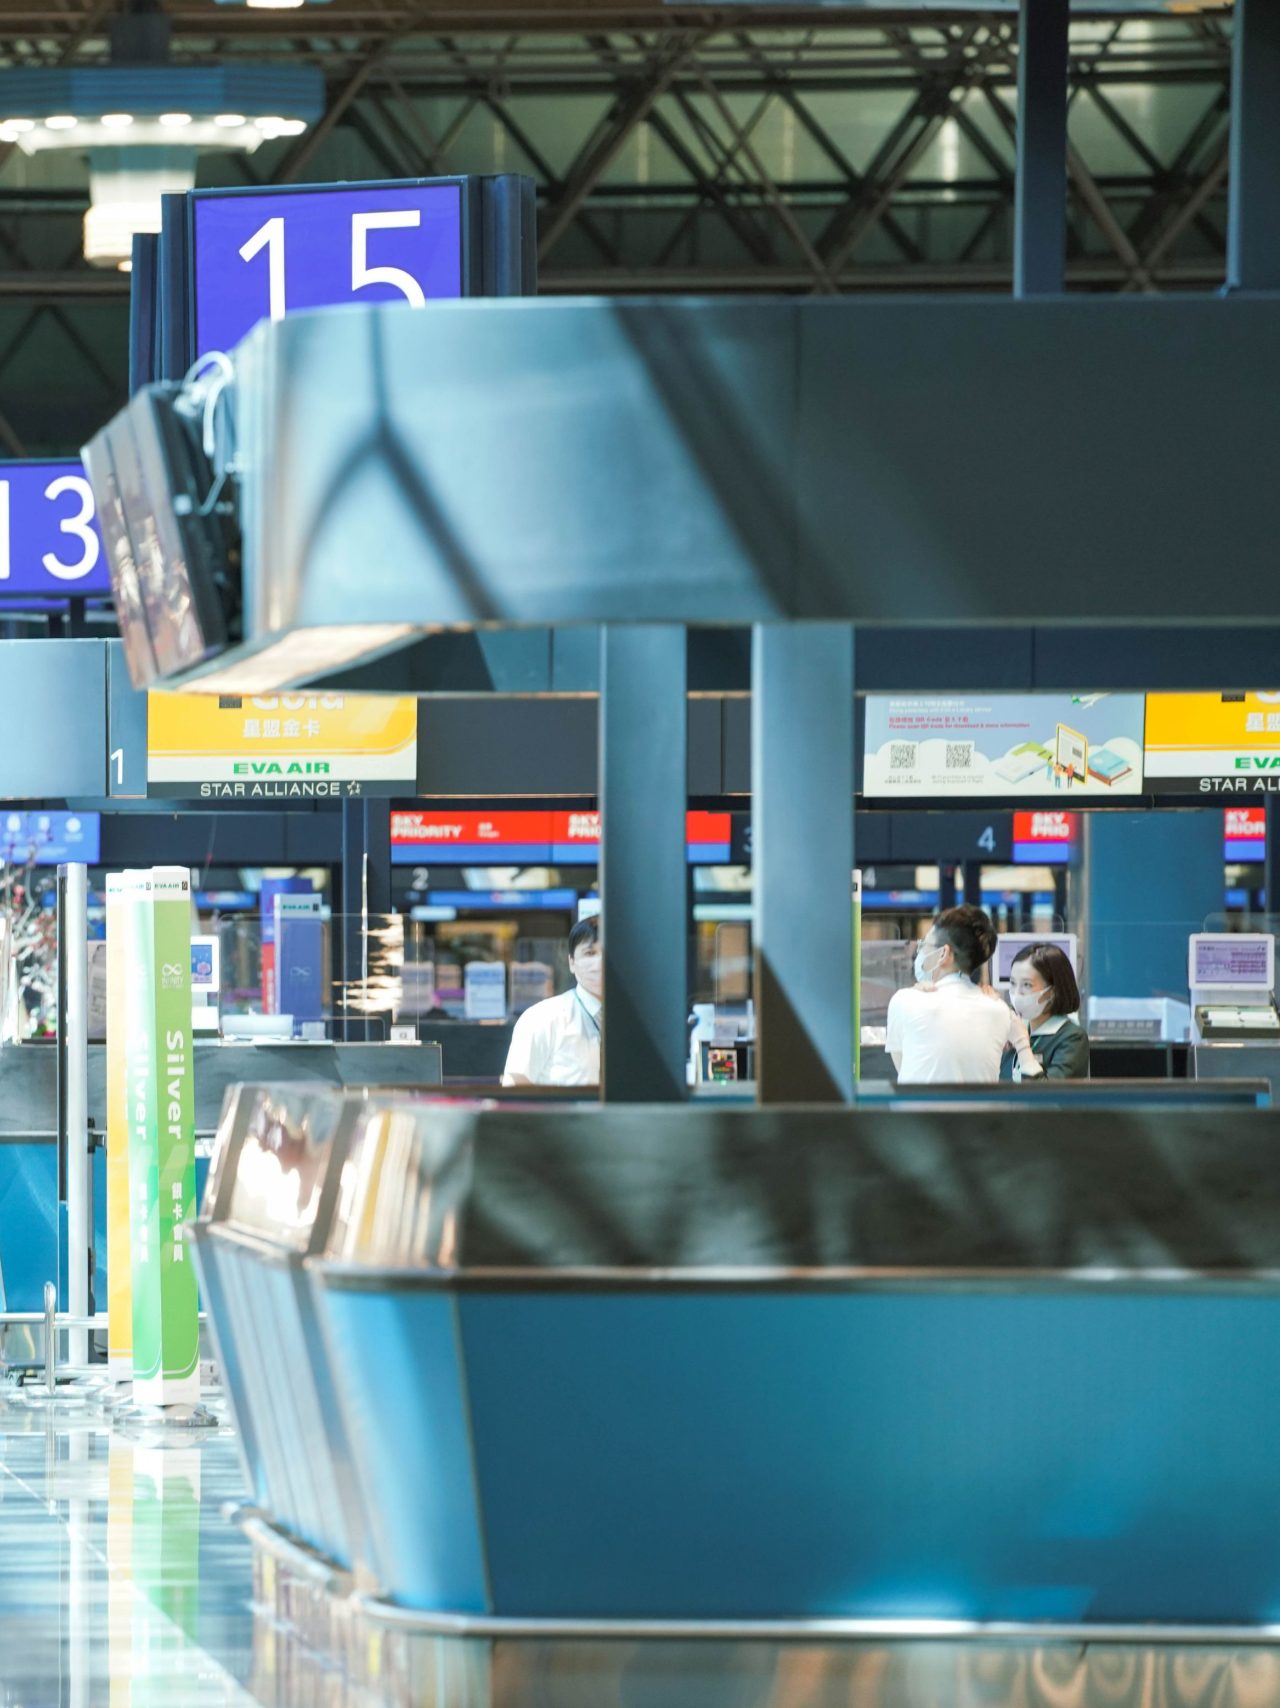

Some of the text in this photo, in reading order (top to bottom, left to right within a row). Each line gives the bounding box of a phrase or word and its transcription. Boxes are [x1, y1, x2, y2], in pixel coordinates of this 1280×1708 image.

[239, 210, 426, 321] 15
[243, 719, 320, 738] 星盟金卡
[110, 748, 124, 785] 1
[200, 782, 341, 797] STAR ALLIANCE
[1199, 777, 1248, 792] STAR
[1225, 811, 1249, 822] KY
[568, 824, 602, 838] PRIO
[976, 826, 996, 852] 4
[1031, 824, 1069, 838] PRIO
[166, 1030, 184, 1139] Silver
